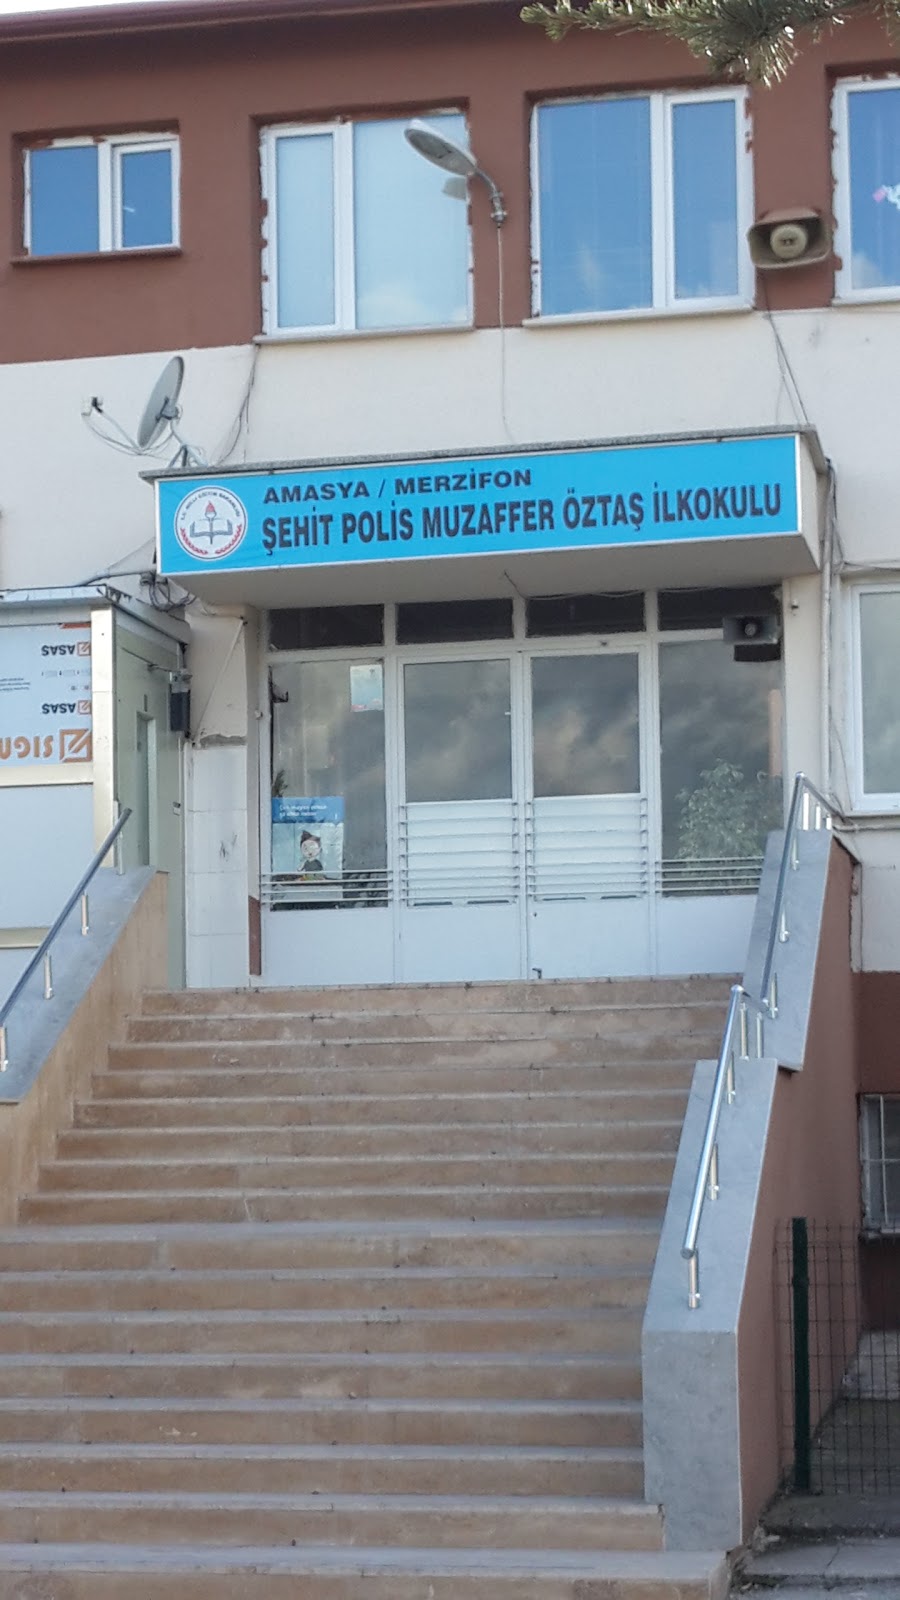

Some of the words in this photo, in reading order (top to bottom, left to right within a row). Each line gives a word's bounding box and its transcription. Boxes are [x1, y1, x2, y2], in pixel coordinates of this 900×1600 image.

[264, 481, 370, 504] AMASYA
[378, 479, 386, 499] /
[395, 468, 531, 495] MERZİFON
[262, 506, 334, 556] ŞEHİT
[342, 499, 414, 544] POLİS
[422, 500, 555, 539] MUZAFFER
[563, 488, 644, 531] ÖZTAŞ
[653, 481, 781, 523] İLKOKULU
[41, 644, 76, 656] ASAS
[41, 702, 76, 714] ASAS
